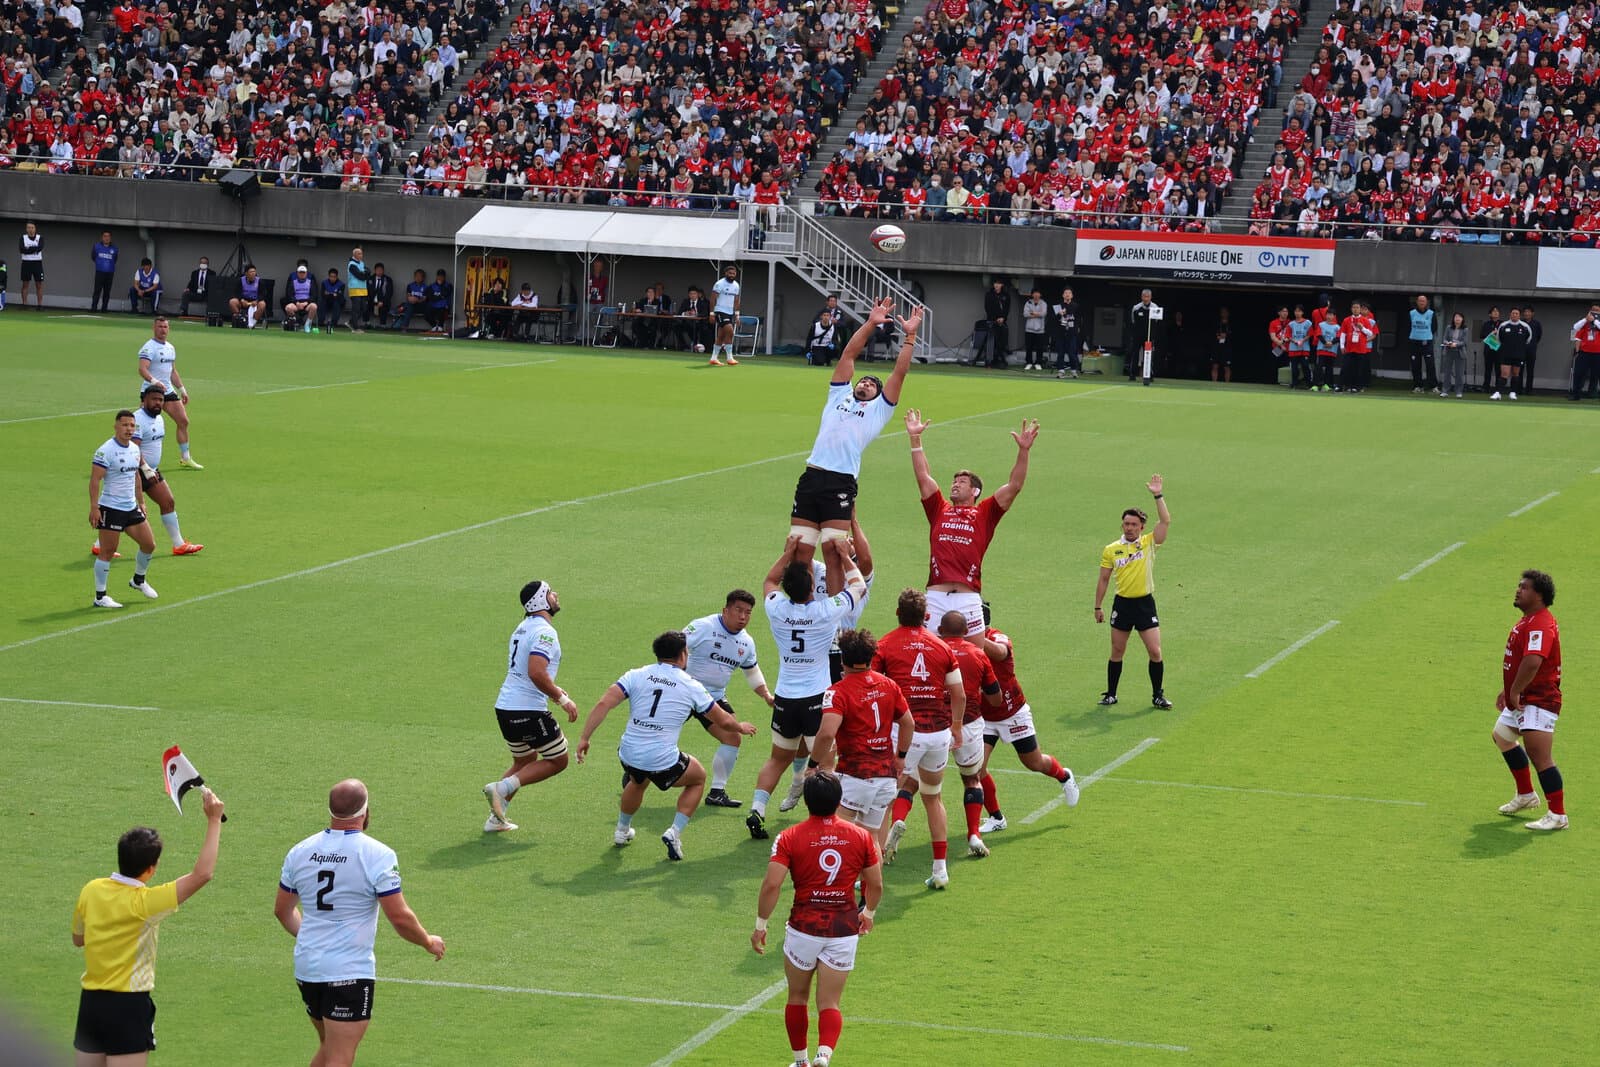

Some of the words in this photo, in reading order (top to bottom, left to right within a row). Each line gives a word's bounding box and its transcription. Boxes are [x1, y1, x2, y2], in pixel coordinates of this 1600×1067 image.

[1116, 248, 1145, 260] JAPAN
[1148, 249, 1178, 262] RUGBY
[1181, 250, 1218, 264] LEAGUE
[1277, 255, 1310, 268] NTT
[941, 522, 975, 533] TOSHIBA
[784, 617, 813, 627] Aquilion
[790, 629, 806, 653] 5
[710, 652, 740, 667] Canon
[911, 652, 931, 682] 4
[646, 675, 677, 688] Aquilion
[649, 688, 663, 718] 1
[871, 701, 881, 733] 1
[309, 852, 348, 865] Aquilion
[819, 848, 842, 886] 9
[316, 870, 336, 911] 2
